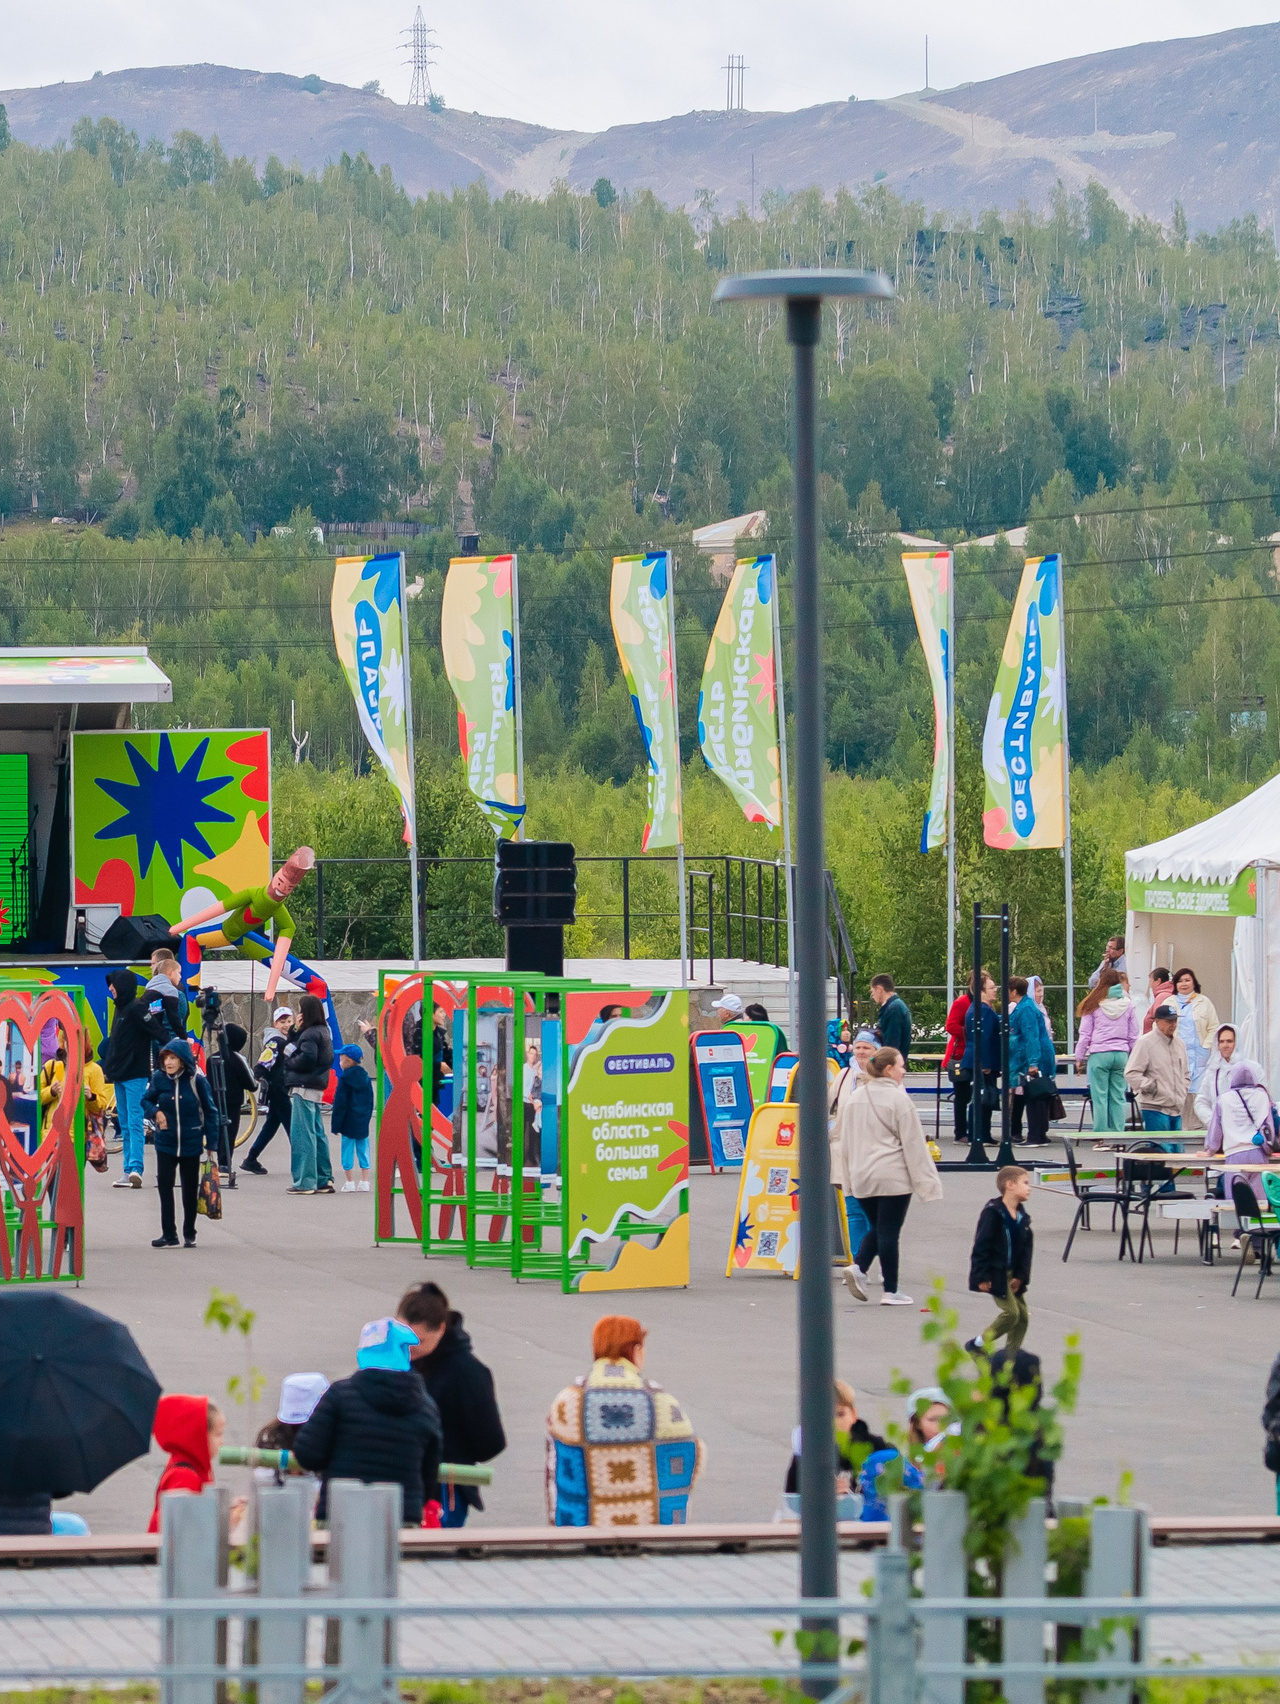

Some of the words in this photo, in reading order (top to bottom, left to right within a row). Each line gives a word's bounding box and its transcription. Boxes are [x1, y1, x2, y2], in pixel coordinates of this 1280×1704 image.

[608, 1057, 671, 1071] ФЕСТИВАЛЬ
[581, 1100, 674, 1120] Челябинская
[592, 1122, 650, 1141] область
[595, 1143, 659, 1161] большая
[607, 1165, 648, 1182] семья
